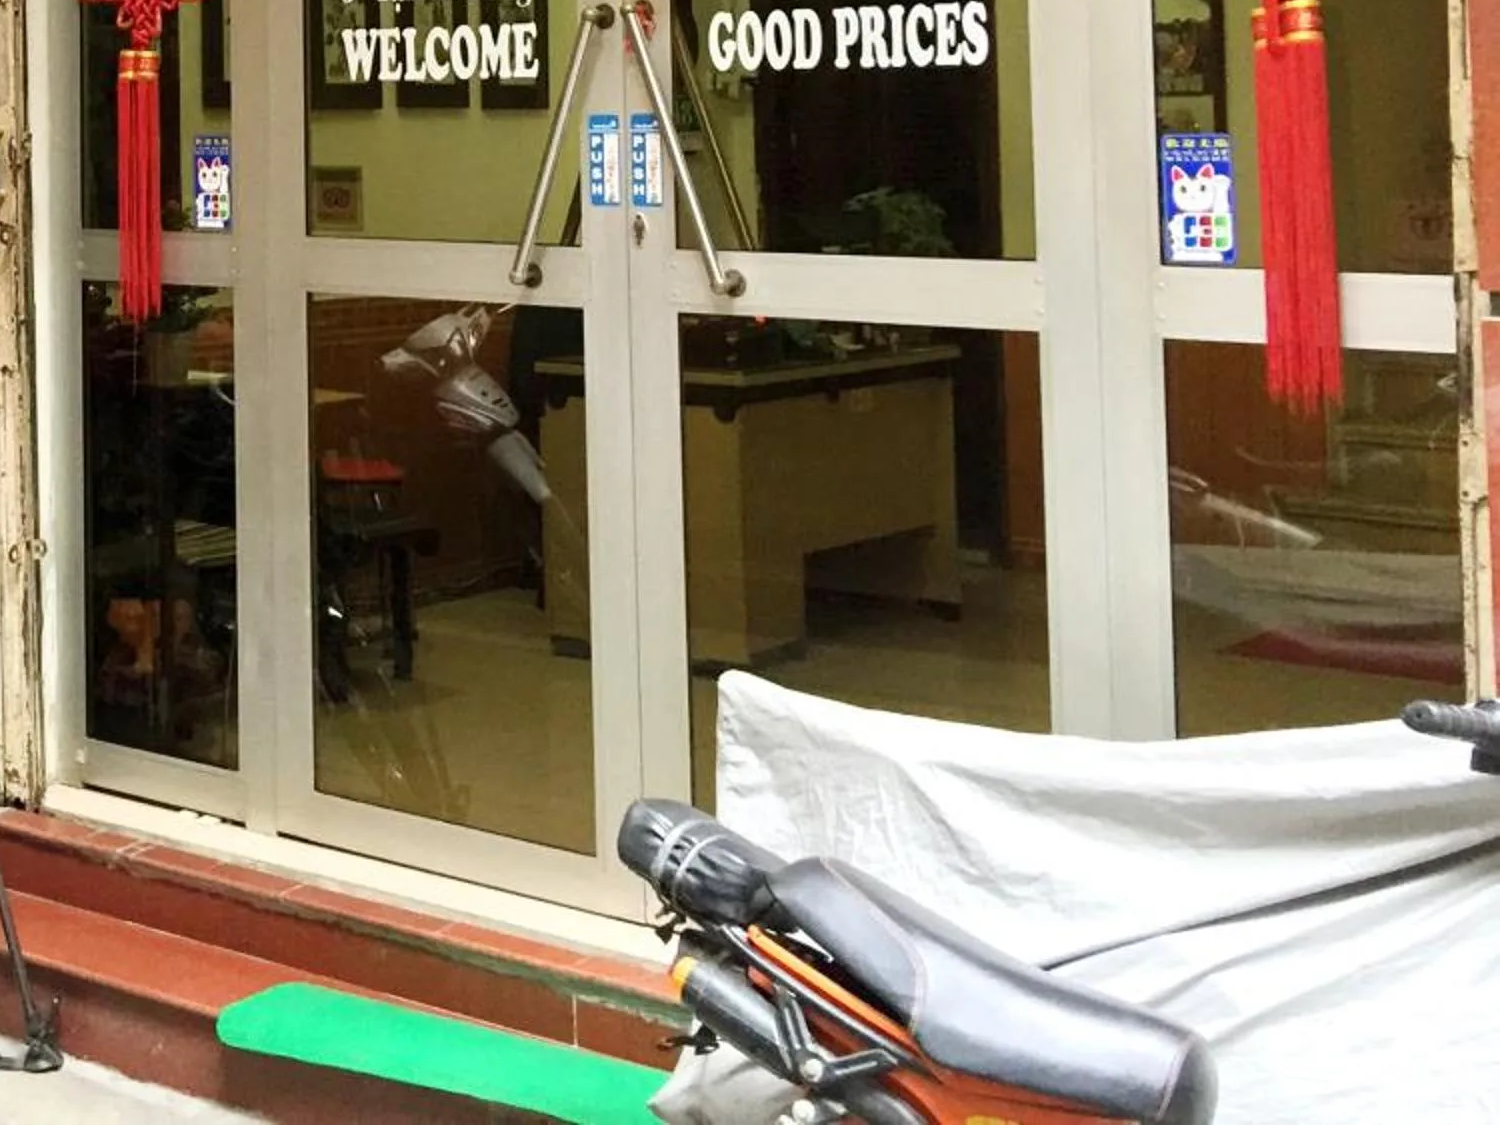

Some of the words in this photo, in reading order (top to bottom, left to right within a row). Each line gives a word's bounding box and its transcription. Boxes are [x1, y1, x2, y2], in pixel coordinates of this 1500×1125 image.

[341, 21, 539, 82] WELCOME
[708, 8, 823, 72] GOOD
[831, 0, 989, 70] PRICES
[591, 135, 603, 195] PUSH
[633, 135, 645, 195] PUSH
